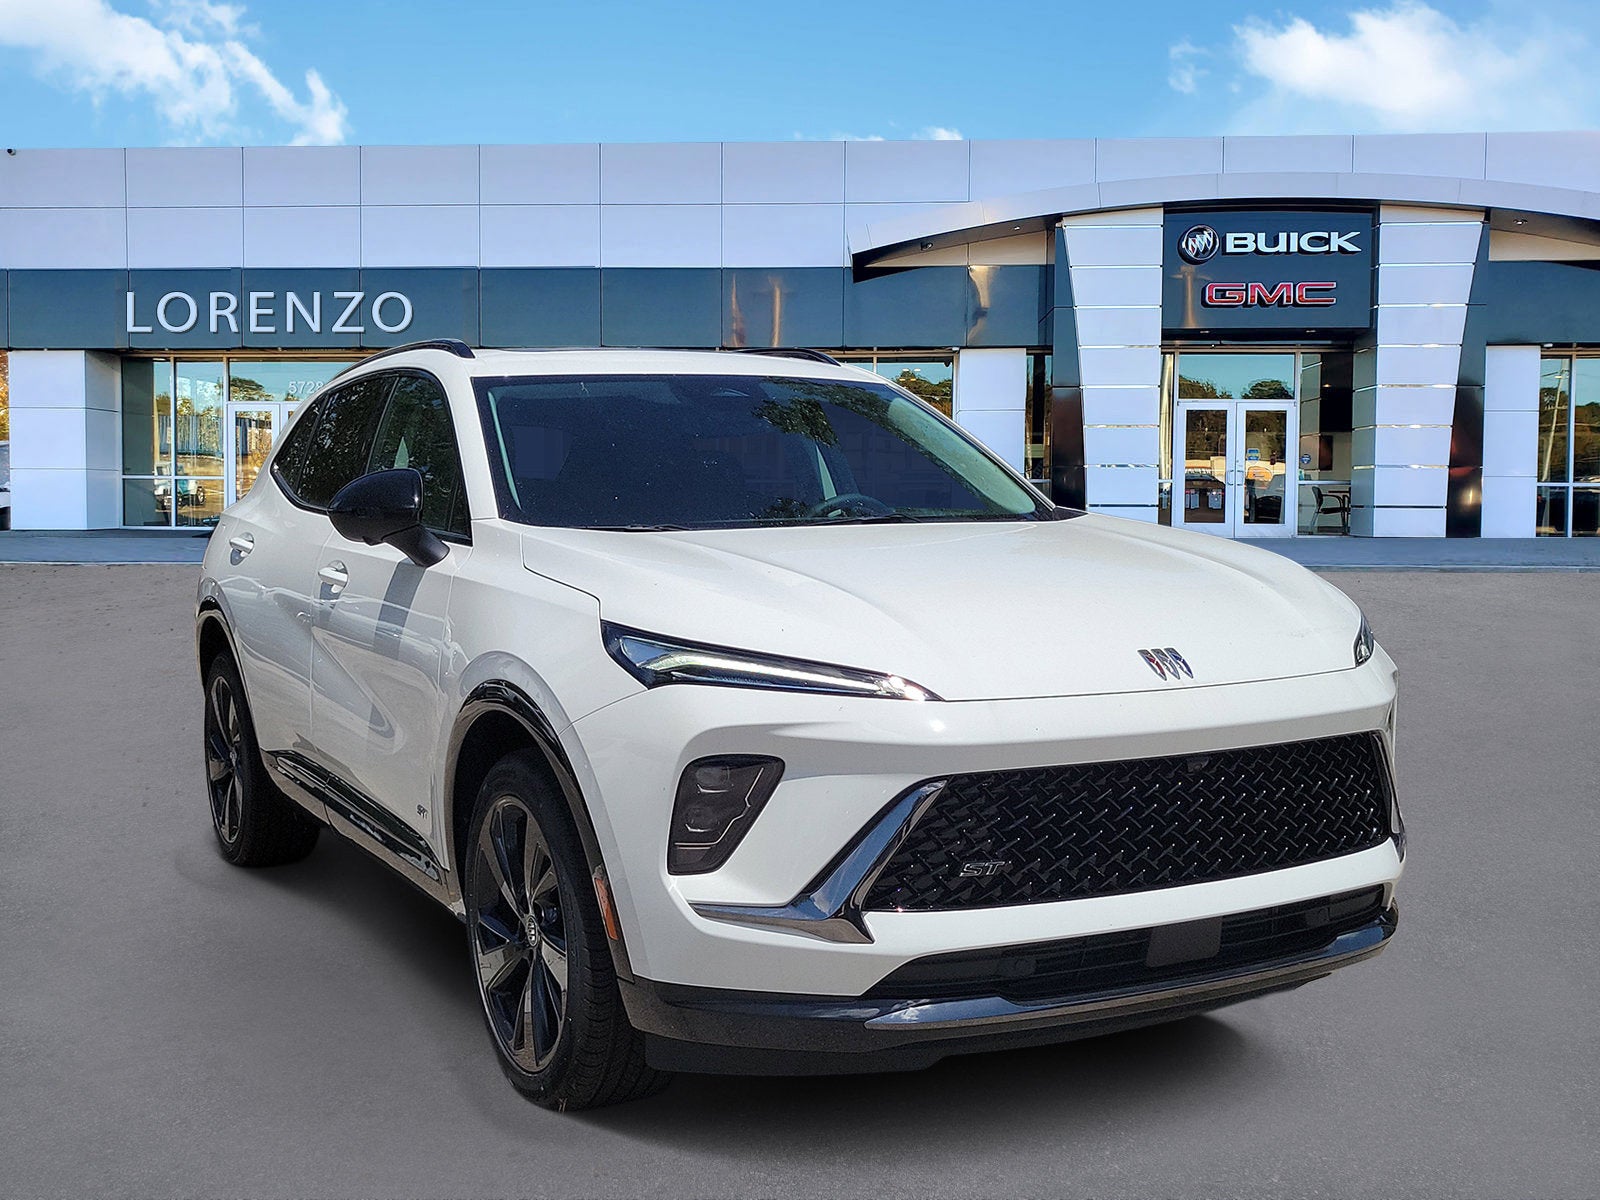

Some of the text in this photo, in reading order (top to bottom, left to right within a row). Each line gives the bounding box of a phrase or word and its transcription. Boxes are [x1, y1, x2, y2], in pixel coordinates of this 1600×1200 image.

[1225, 231, 1362, 253] BUICK
[1205, 282, 1337, 306] GMC
[126, 291, 413, 333] LORENZO
[959, 861, 1005, 877] ST
